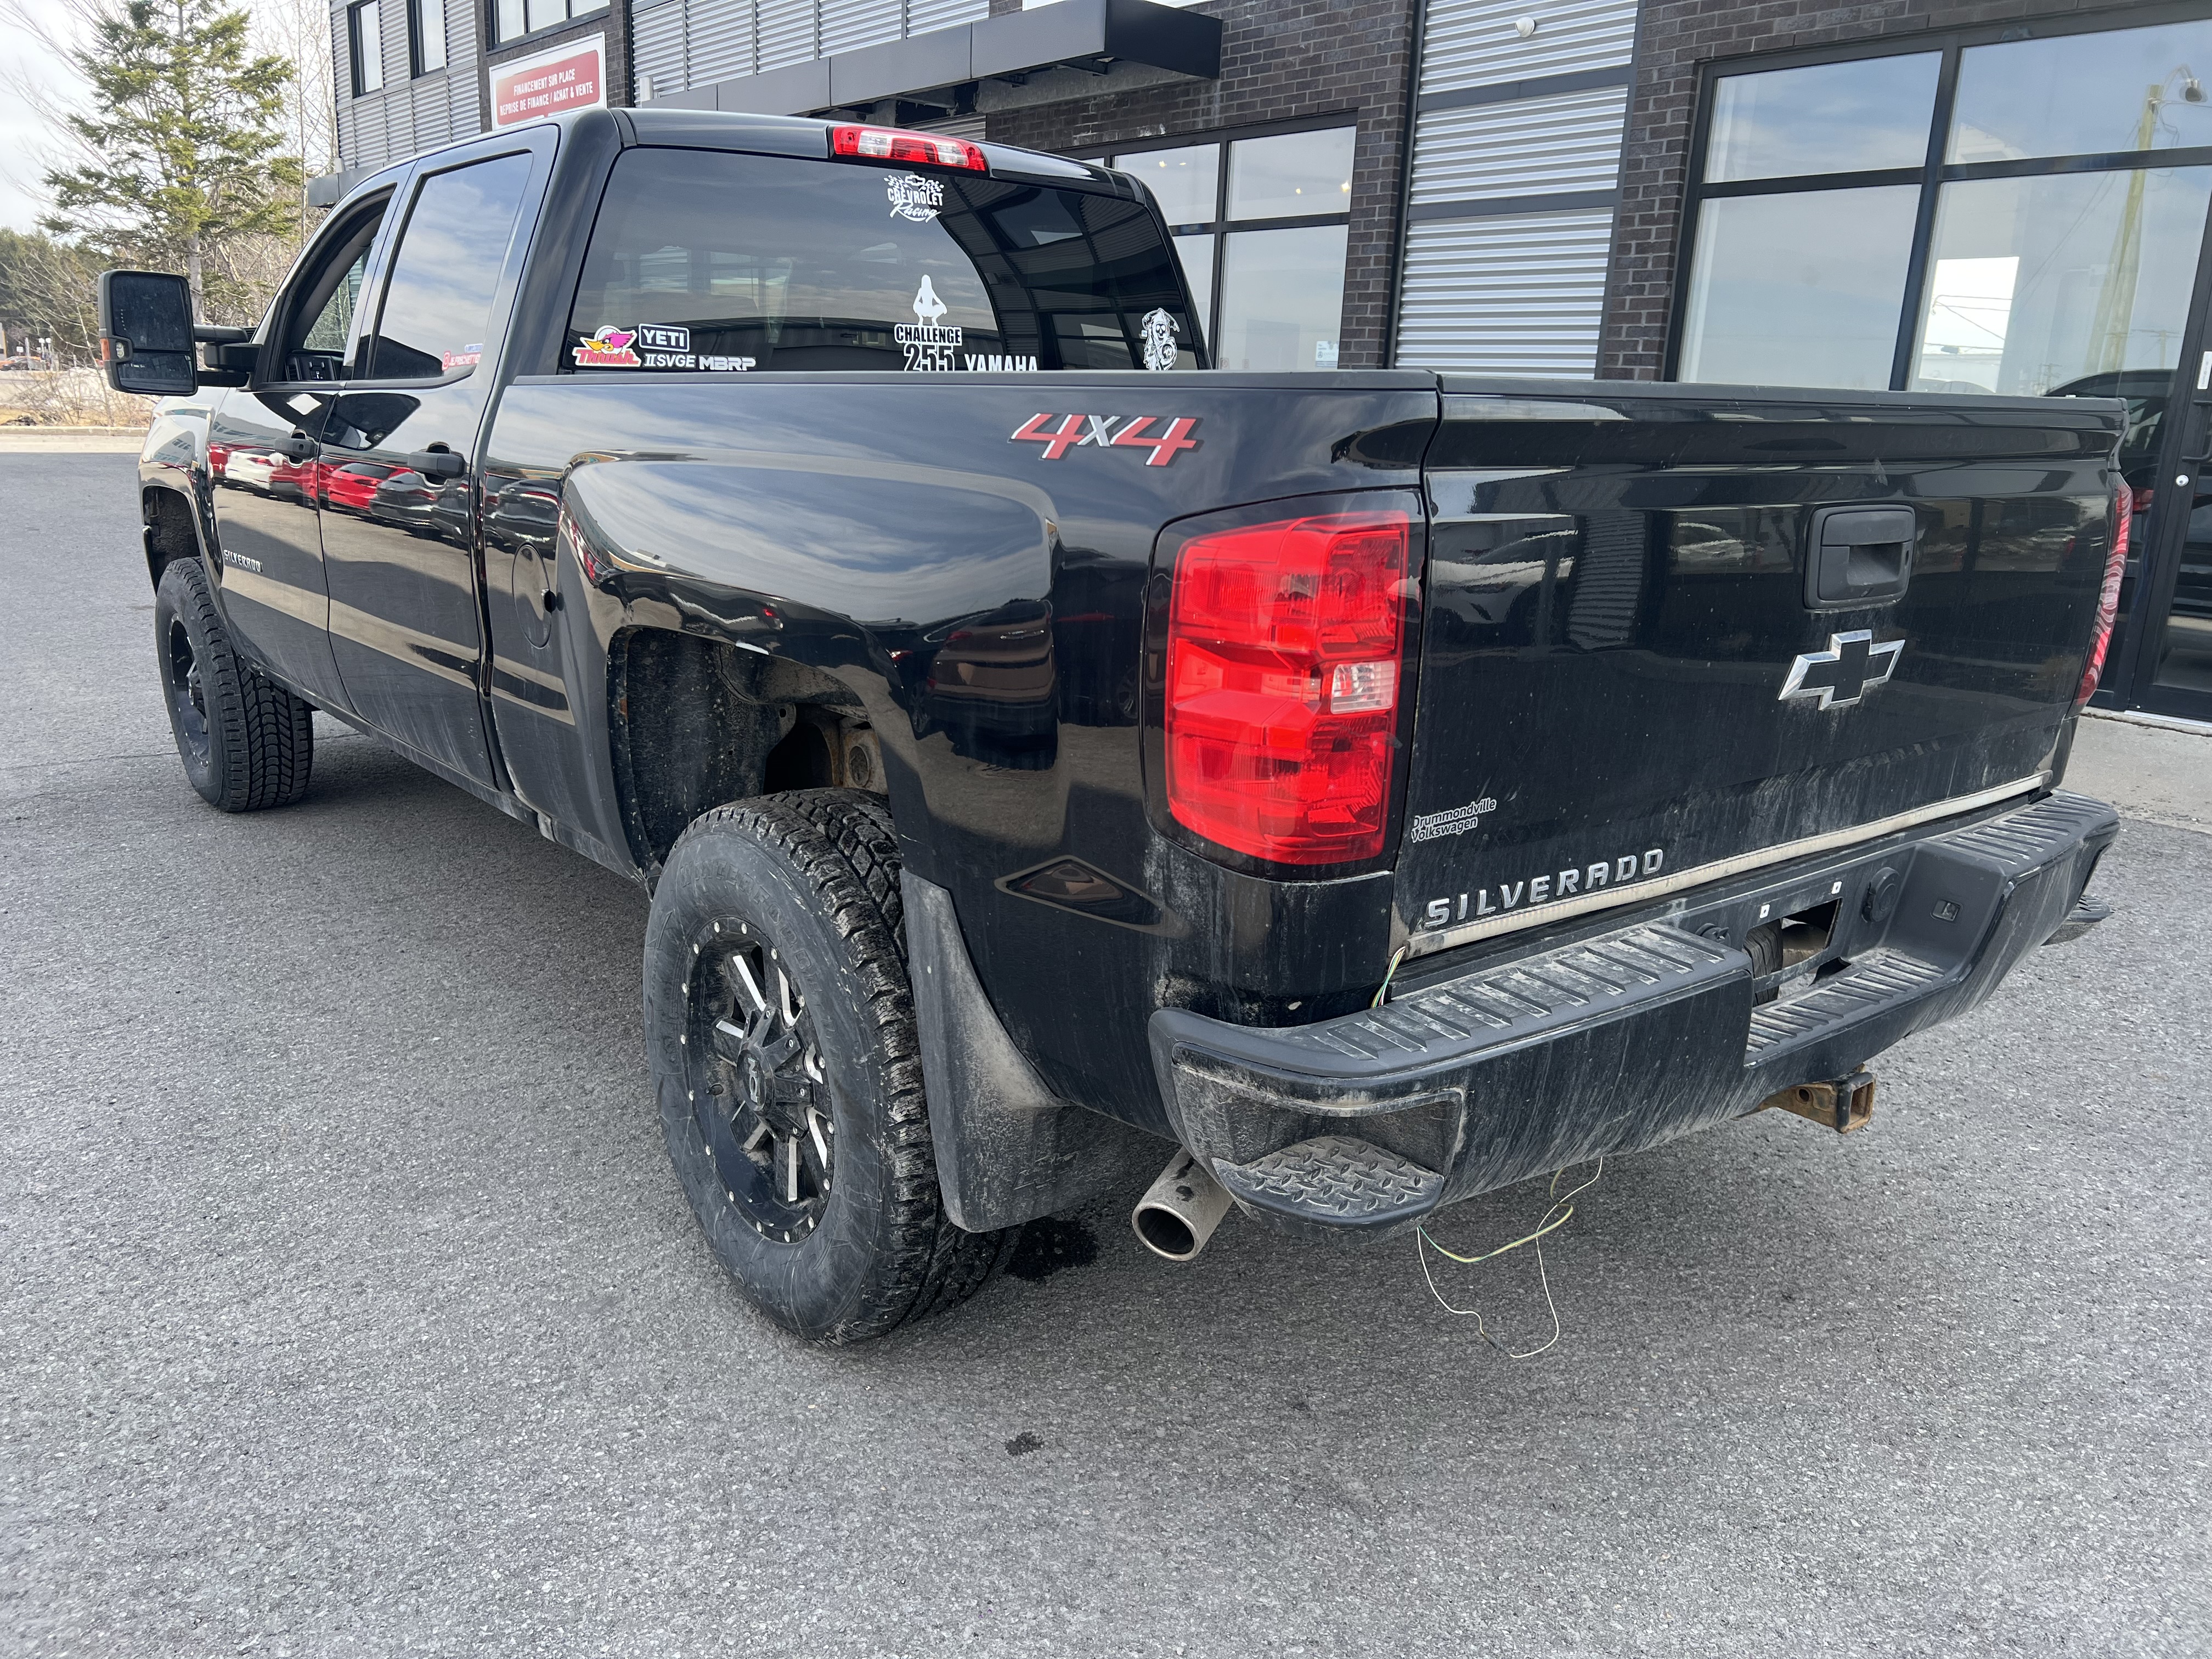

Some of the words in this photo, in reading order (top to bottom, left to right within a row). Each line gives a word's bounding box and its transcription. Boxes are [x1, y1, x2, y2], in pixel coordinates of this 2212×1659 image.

[514, 77, 548, 96] FINANCEMENT
[548, 74, 557, 87] SUR
[558, 68, 575, 84] PLACE
[499, 100, 519, 116] REPRISE
[520, 99, 527, 111] DE
[527, 93, 549, 109] FINANCE
[553, 87, 568, 103] ACHAT
[570, 87, 574, 98] &
[575, 81, 593, 97] VENTE
[887, 187, 943, 206] CHEVROLET
[889, 201, 942, 223] Racing
[642, 329, 685, 347] YETI
[895, 325, 961, 345] CHALLENGE
[575, 349, 640, 365] Thrush
[699, 356, 756, 371] MBRP
[904, 343, 955, 372] 255
[964, 354, 1037, 372] YAMAHA
[223, 549, 262, 573] SILVERADO
[1413, 797, 1497, 828] Drummondville
[1410, 816, 1479, 843] Volkswagen
[1424, 848, 1663, 927] SILVERADO
